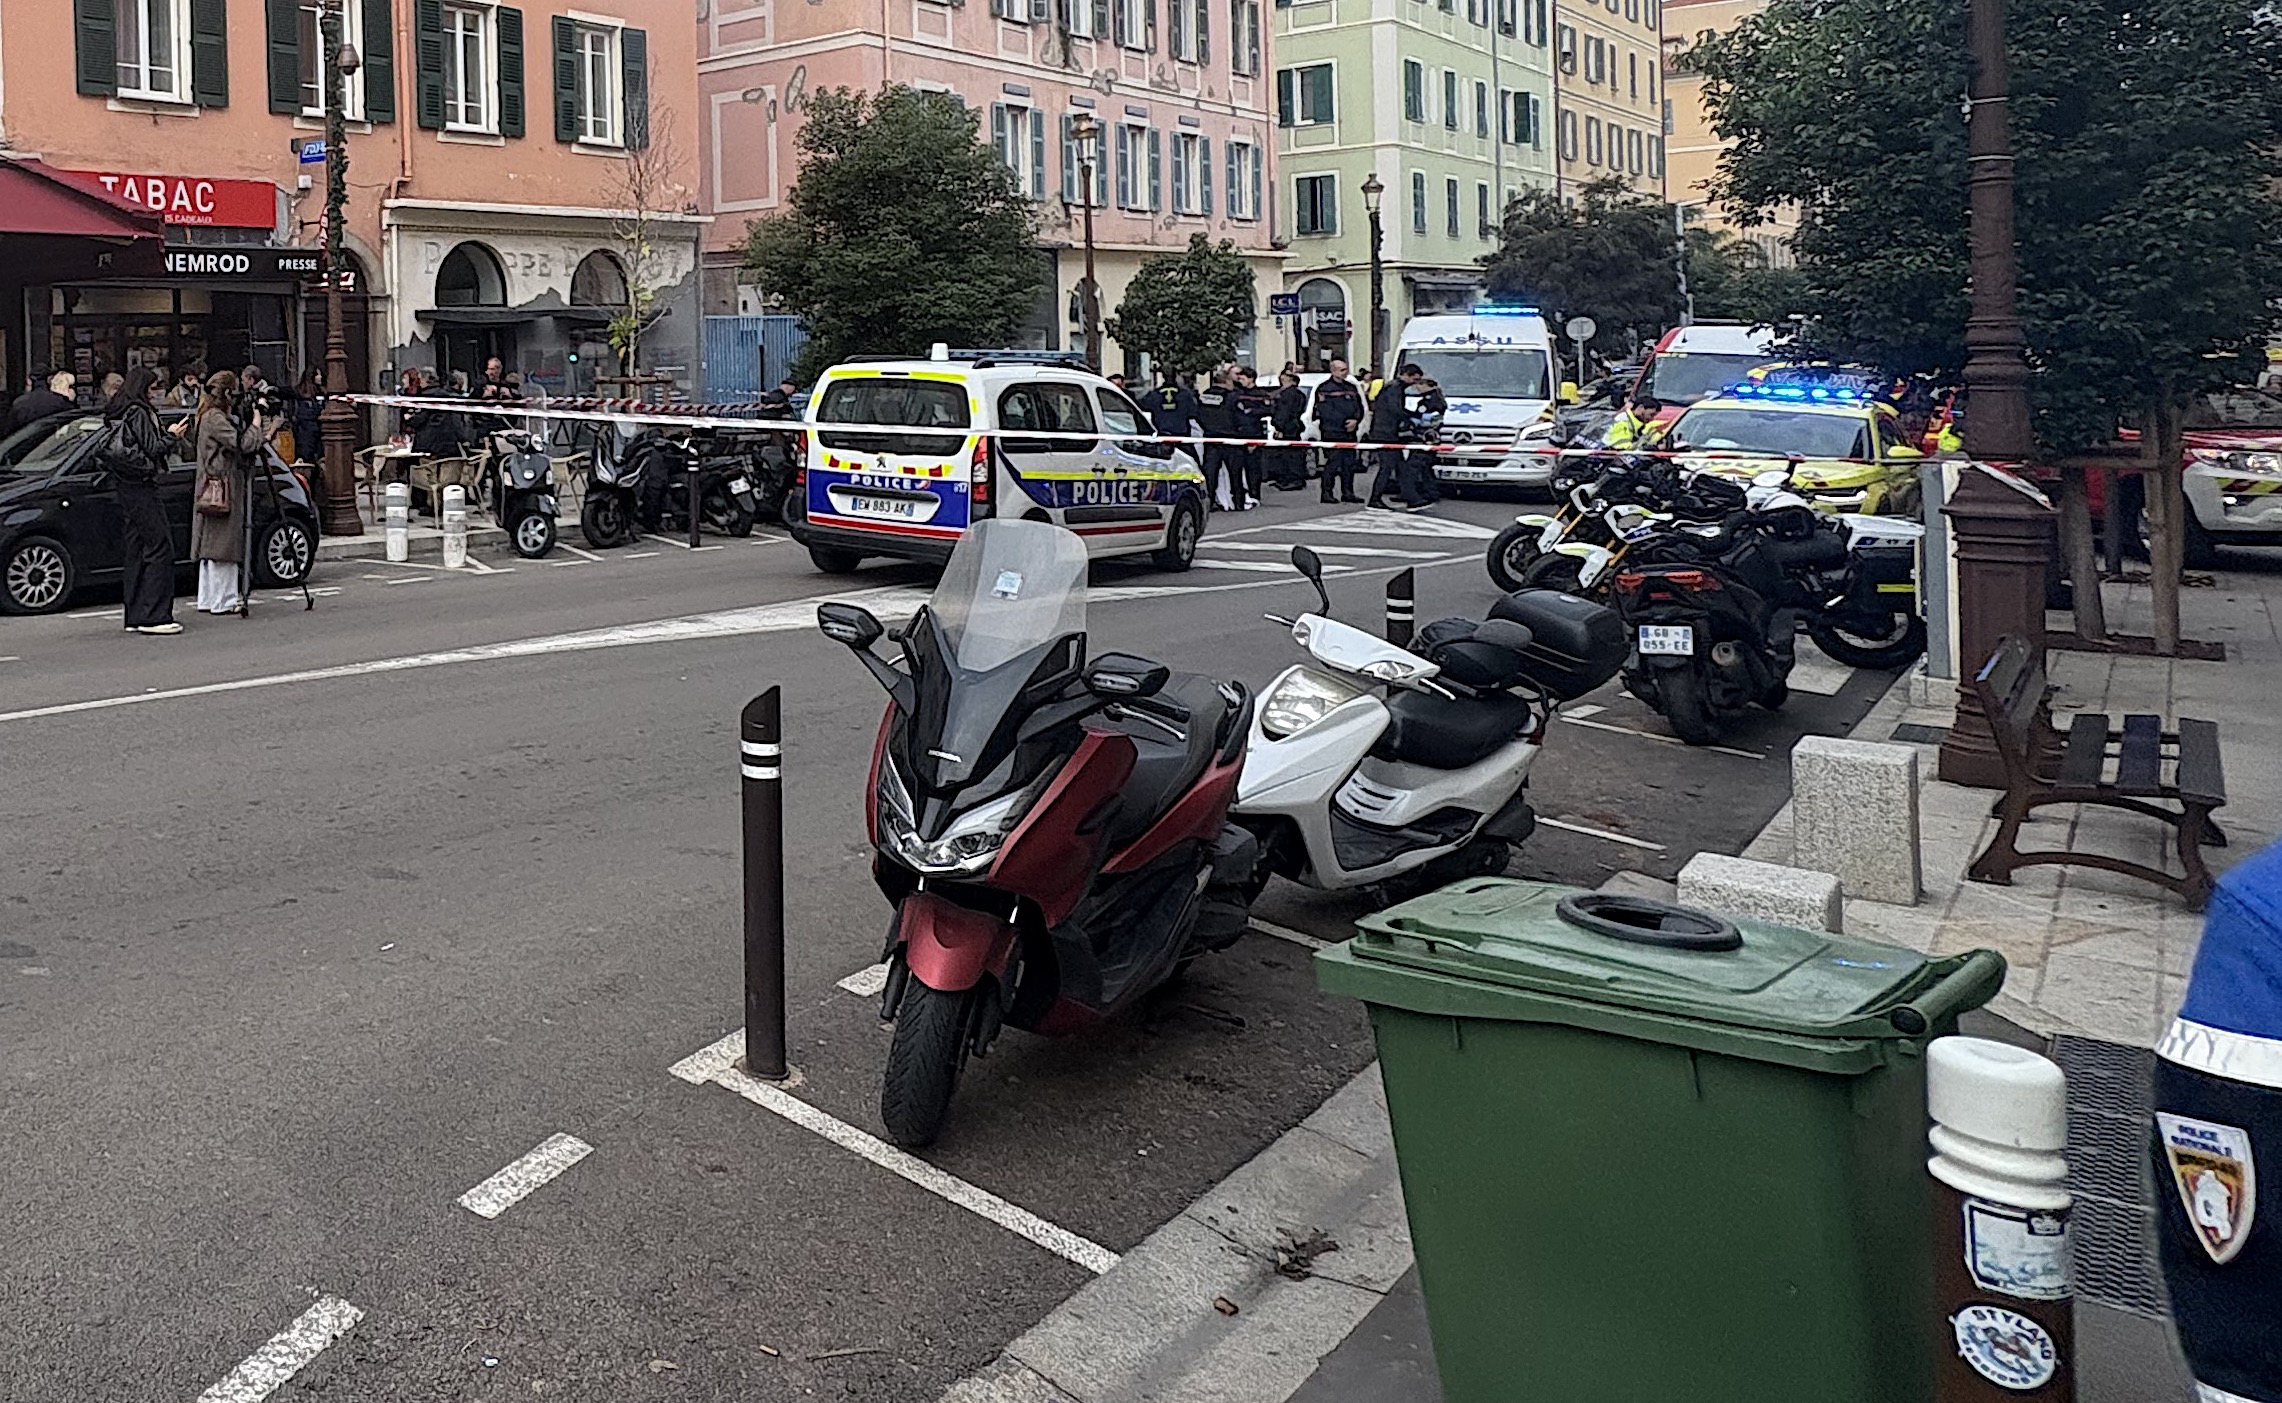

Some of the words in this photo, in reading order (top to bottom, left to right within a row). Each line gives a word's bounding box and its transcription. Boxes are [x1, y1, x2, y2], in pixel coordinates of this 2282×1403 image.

[99, 176, 214, 213] TABAC
[165, 253, 249, 273] NEMROD
[278, 258, 318, 270] PRESSE
[851, 474, 912, 489] POLICE
[1073, 481, 1139, 504] POLICE
[873, 500, 891, 512] 883
[894, 502, 907, 513] AK
[2178, 1125, 2218, 1142] POLICE
